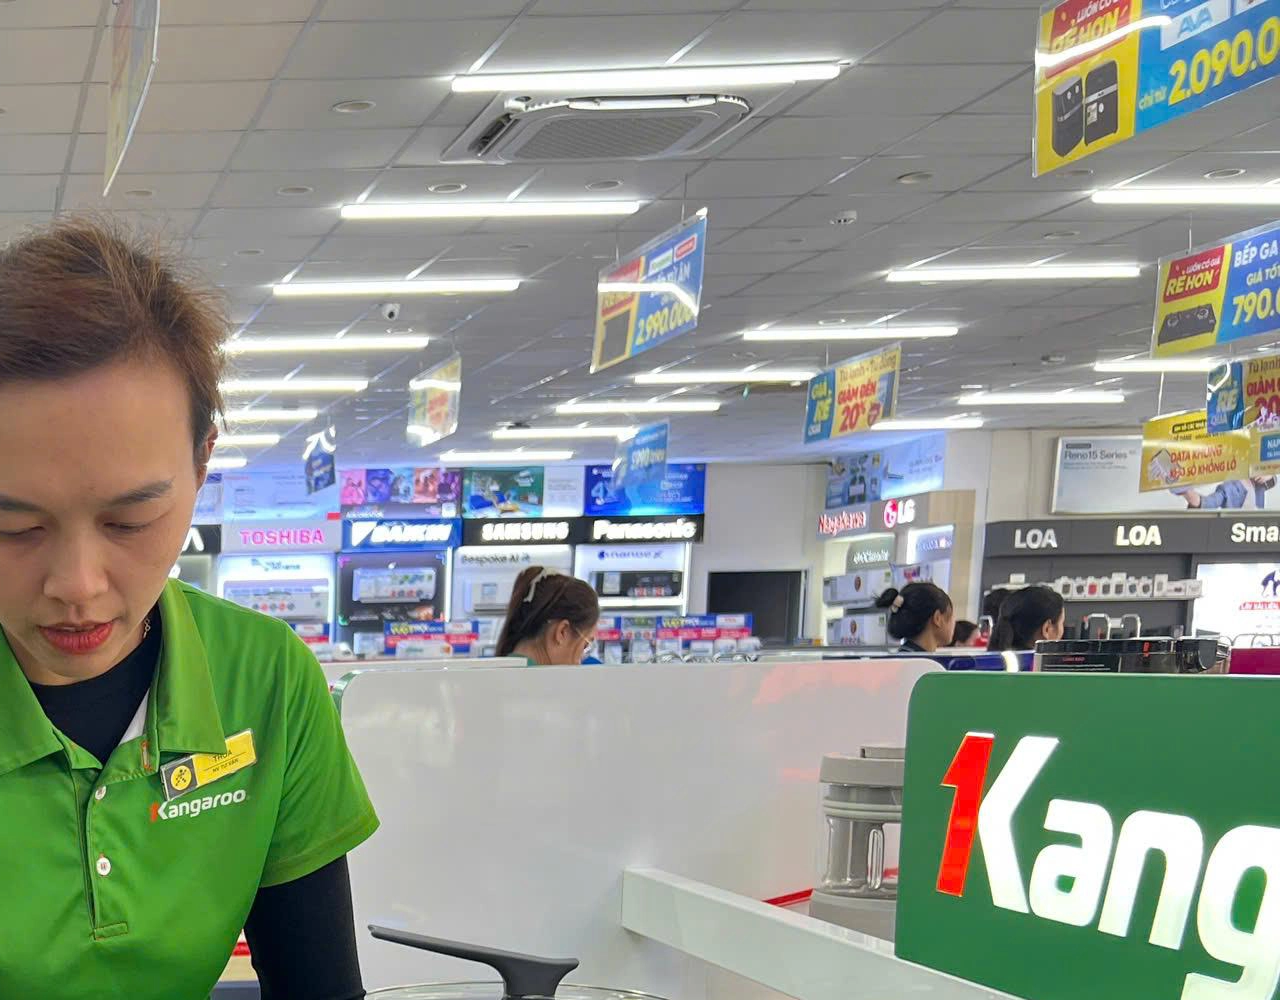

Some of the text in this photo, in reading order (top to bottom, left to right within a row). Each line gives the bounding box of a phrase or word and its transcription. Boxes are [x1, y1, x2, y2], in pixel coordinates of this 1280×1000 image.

[1233, 238, 1279, 268] BẾP GA
[1246, 268, 1263, 286] GIÁ
[239, 526, 325, 546] TOSHIBA
[370, 521, 453, 544] DAIKIN
[481, 520, 570, 542] SAMSUNG
[592, 517, 698, 541] Panasonic
[1014, 528, 1058, 549] LOA
[1115, 524, 1162, 546] LOA
[1230, 522, 1280, 543] Sma
[150, 789, 247, 823] Kangaroo
